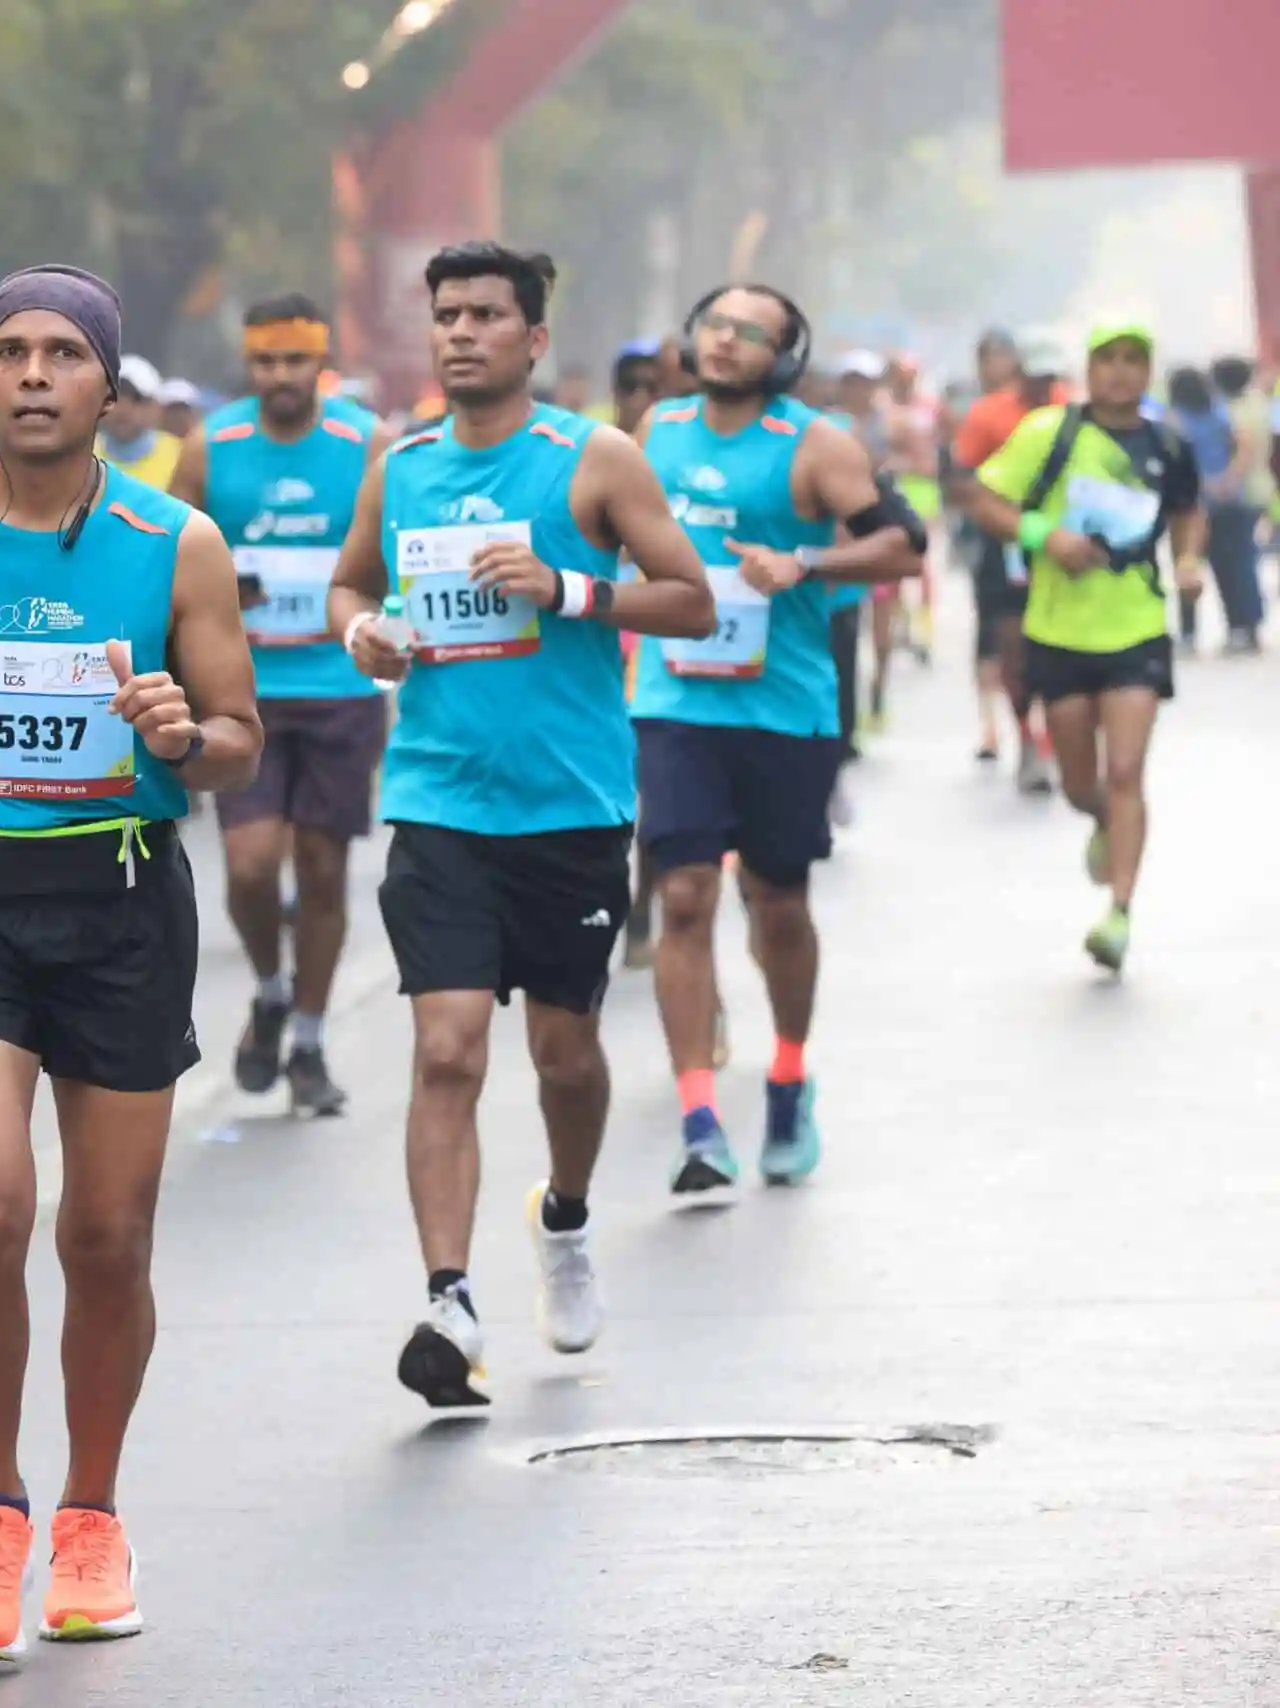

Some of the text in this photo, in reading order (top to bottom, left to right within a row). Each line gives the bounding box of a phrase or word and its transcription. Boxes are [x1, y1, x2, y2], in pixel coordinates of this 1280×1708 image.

[3, 672, 26, 687] tcs
[13, 784, 87, 794] IDFC FIRST Bank
